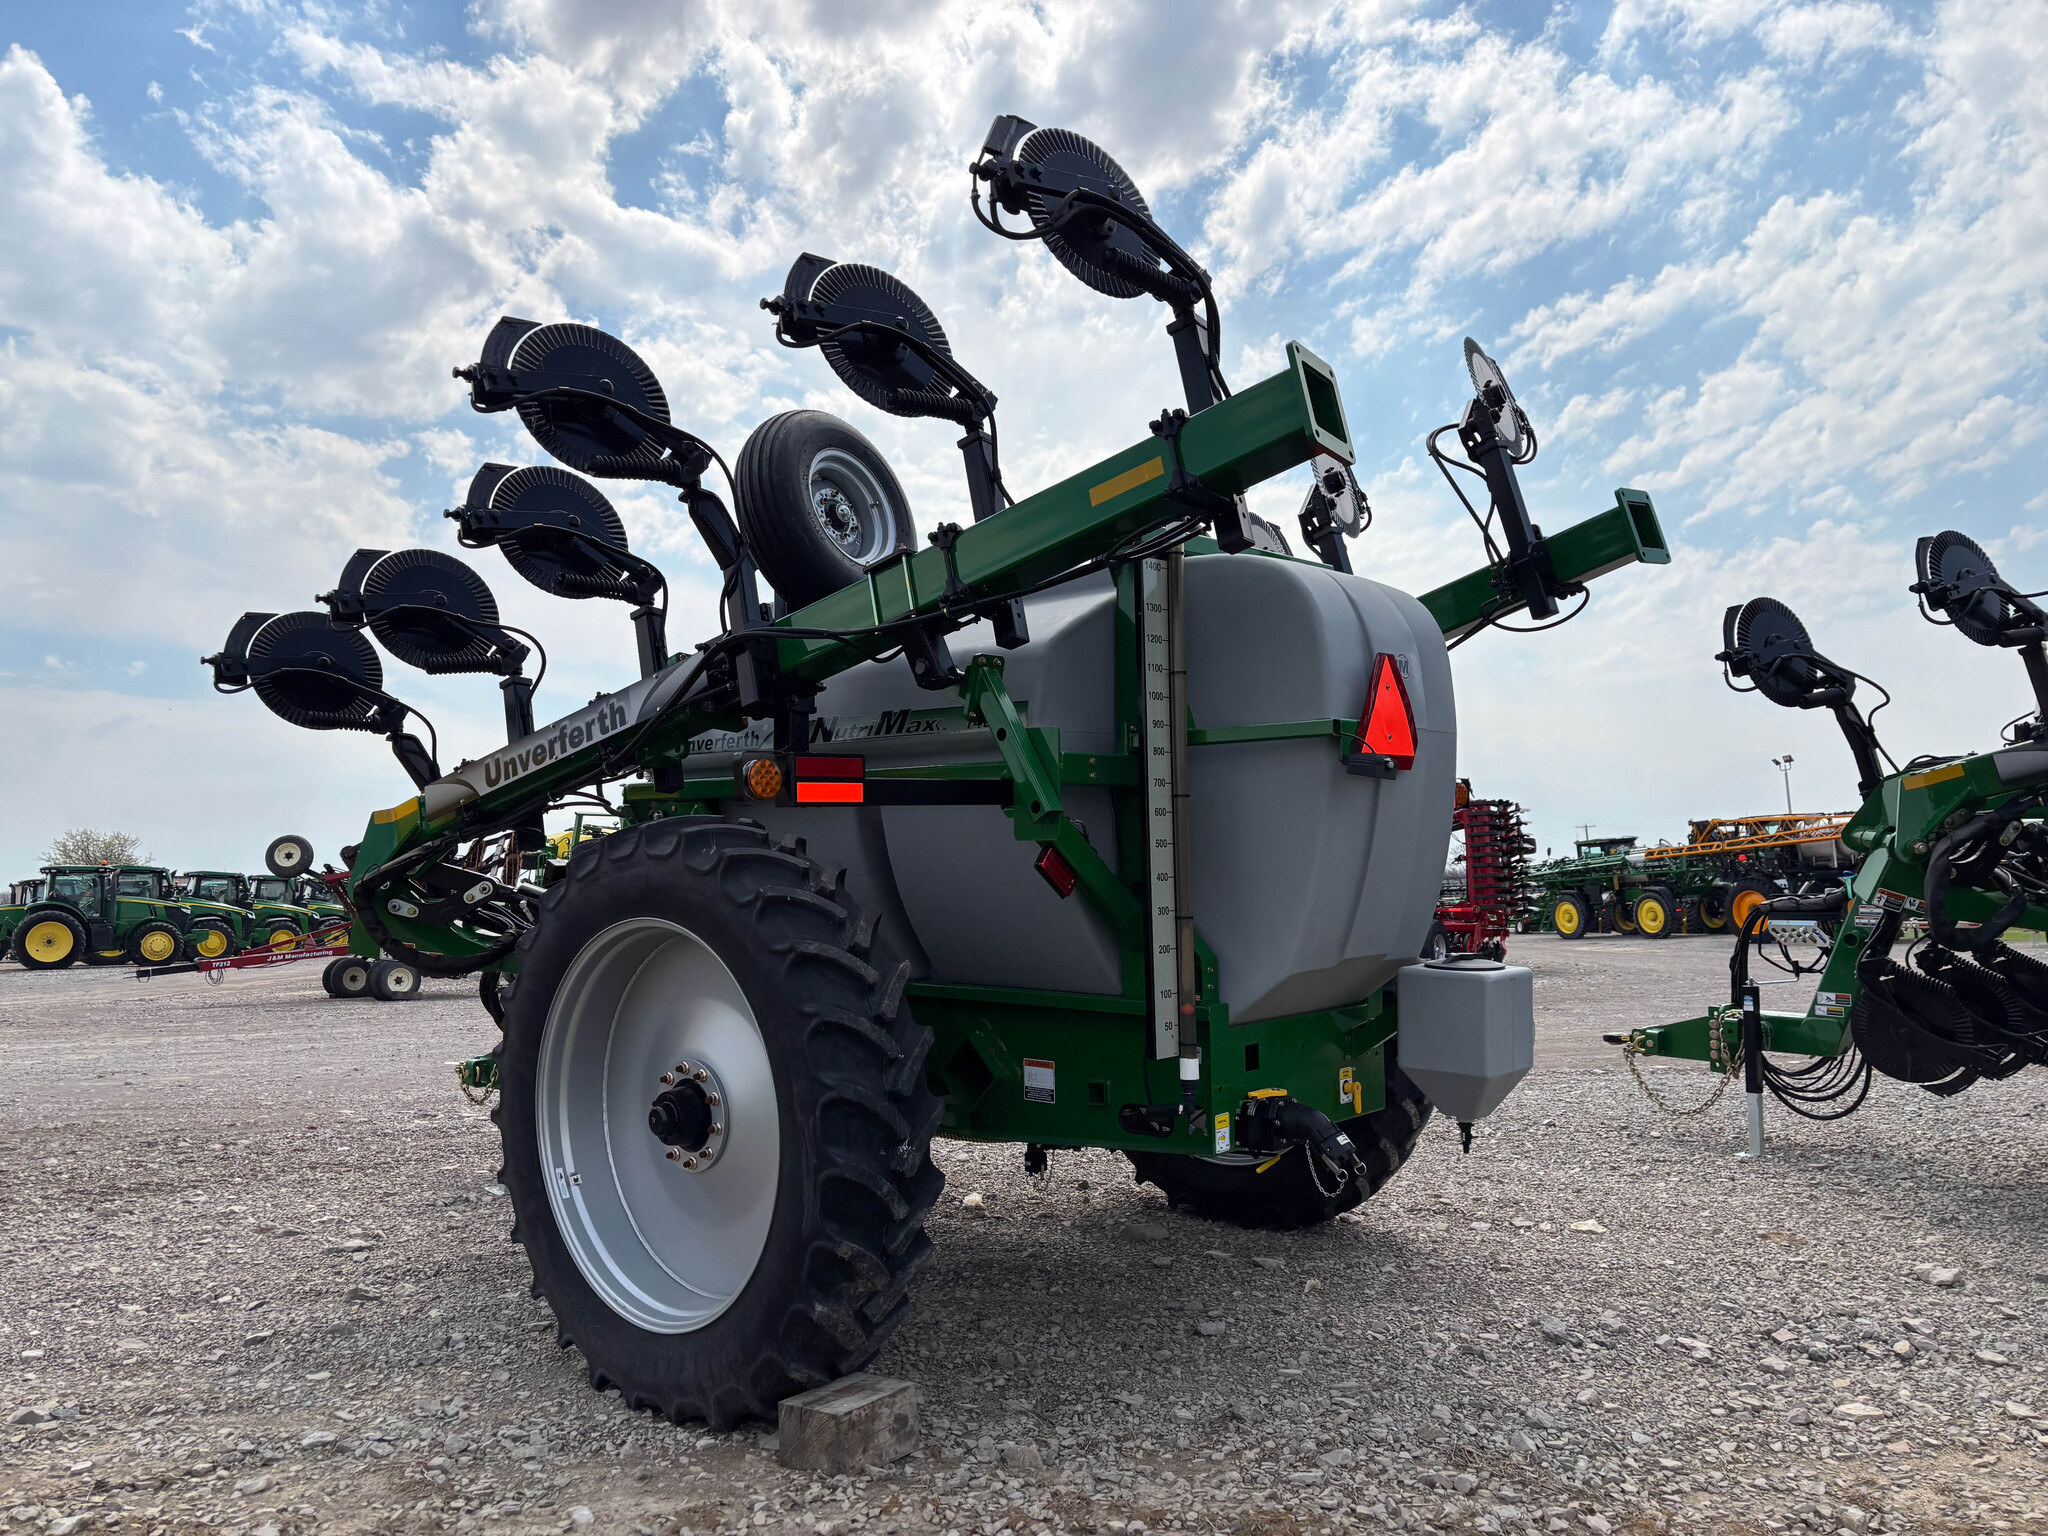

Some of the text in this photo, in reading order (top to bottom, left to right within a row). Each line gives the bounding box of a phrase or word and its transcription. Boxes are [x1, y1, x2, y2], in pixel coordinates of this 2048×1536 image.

[1145, 561, 1162, 572] 1400
[1146, 602, 1162, 613] 1300
[1146, 634, 1163, 644] 1200
[1147, 663, 1163, 673] 1100
[1148, 691, 1164, 701] 1000
[1152, 719, 1165, 729] 900
[484, 702, 628, 789] Unverferth
[688, 730, 760, 751] nverferth
[1153, 746, 1165, 756] 800
[1154, 778, 1166, 788] 700
[1154, 807, 1167, 817] 600
[1155, 838, 1168, 848] 500
[1156, 872, 1169, 882] 400
[1157, 906, 1170, 916] 300
[1158, 944, 1171, 954] 200
[284, 949, 334, 960] Manufacturing
[211, 960, 231, 969] TF212
[1160, 989, 1172, 999] 100
[1164, 1021, 1173, 1031] 50
